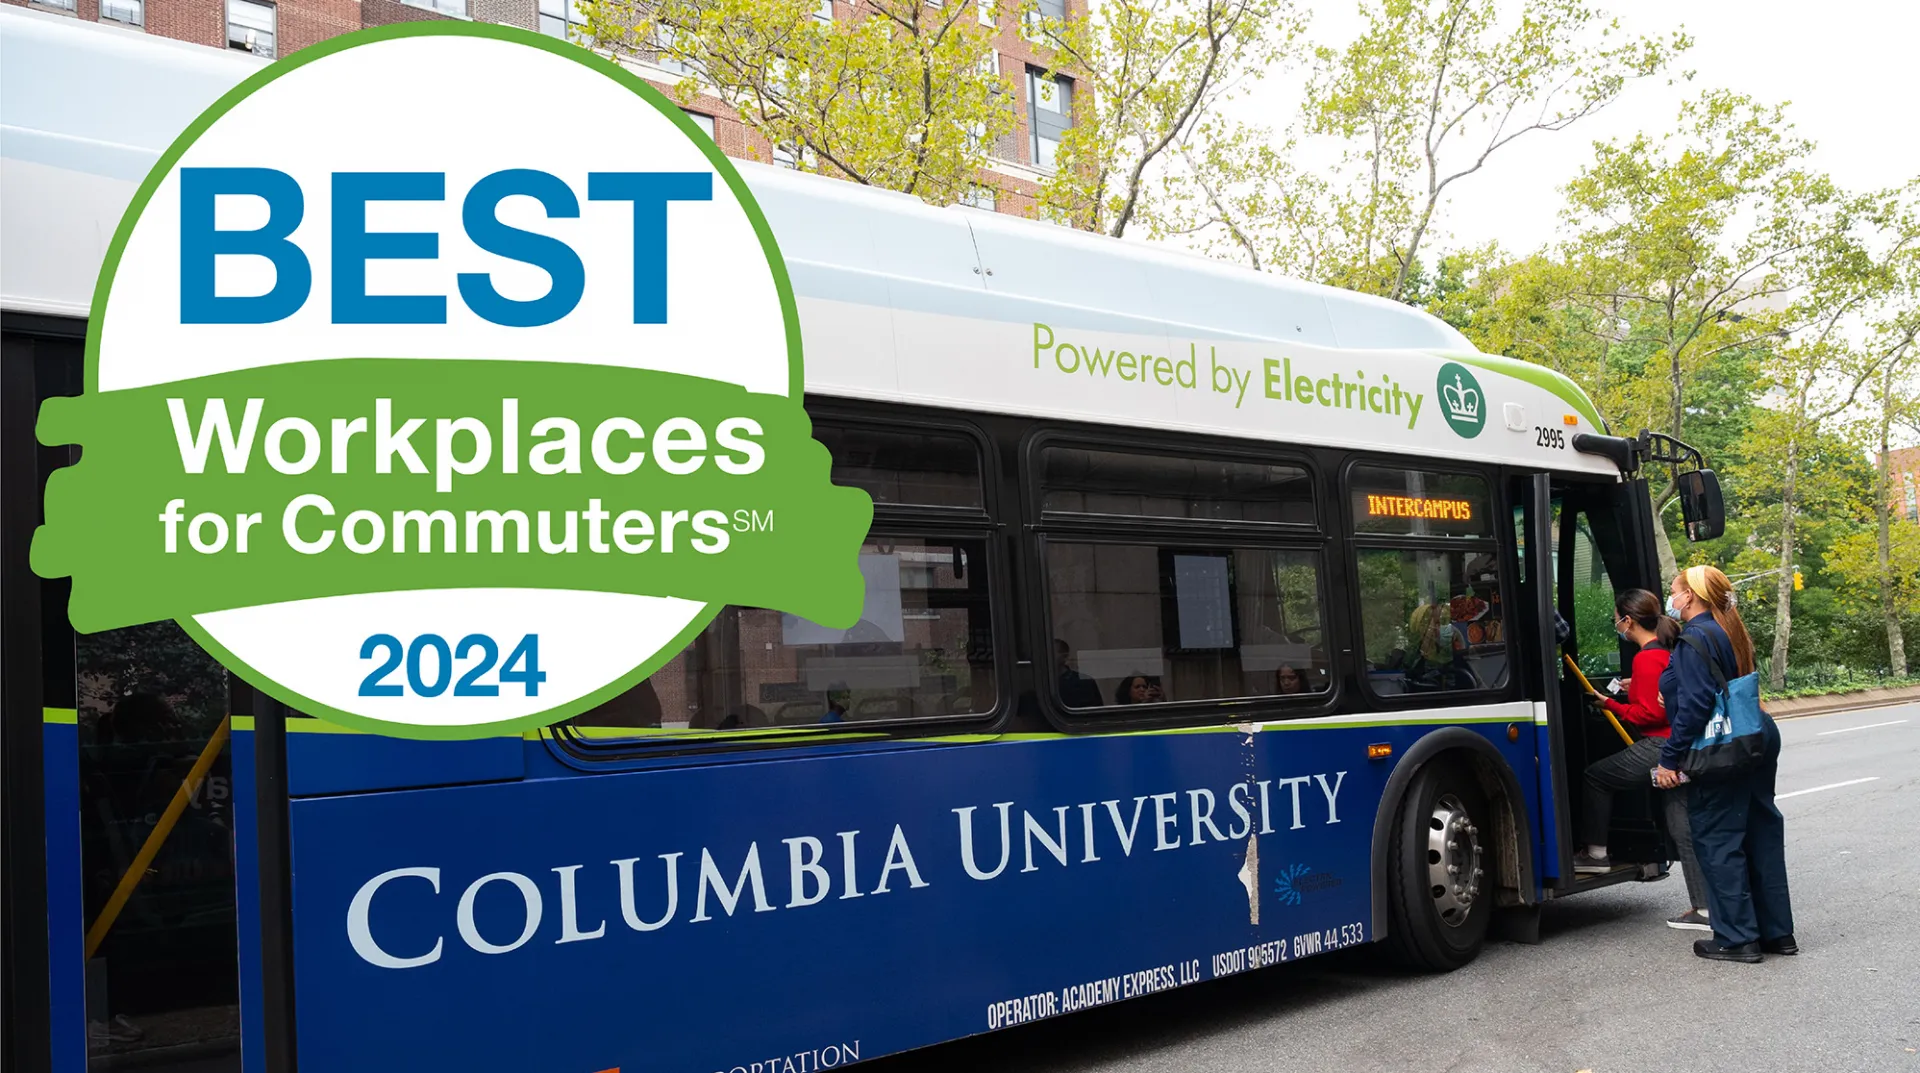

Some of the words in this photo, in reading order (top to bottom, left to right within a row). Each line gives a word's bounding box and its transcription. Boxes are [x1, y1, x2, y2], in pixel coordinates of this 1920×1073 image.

[1033, 322, 1197, 389] Powered
[1211, 346, 1251, 409] by
[1263, 357, 1424, 430] Electricity
[1535, 426, 1565, 450] 2995
[1367, 494, 1471, 520] INTERCAMPUS
[346, 823, 930, 969] COLUMBIA
[951, 771, 1348, 881] UNIVERSITY
[987, 991, 1059, 1029] OPERATOR:
[1062, 976, 1121, 1012] ACADEMY
[1180, 958, 1200, 985] LLC
[1212, 948, 1246, 977] USDOT
[1248, 938, 1288, 969] 905572
[1293, 931, 1322, 958] GVWR
[1324, 921, 1364, 949] 44,533
